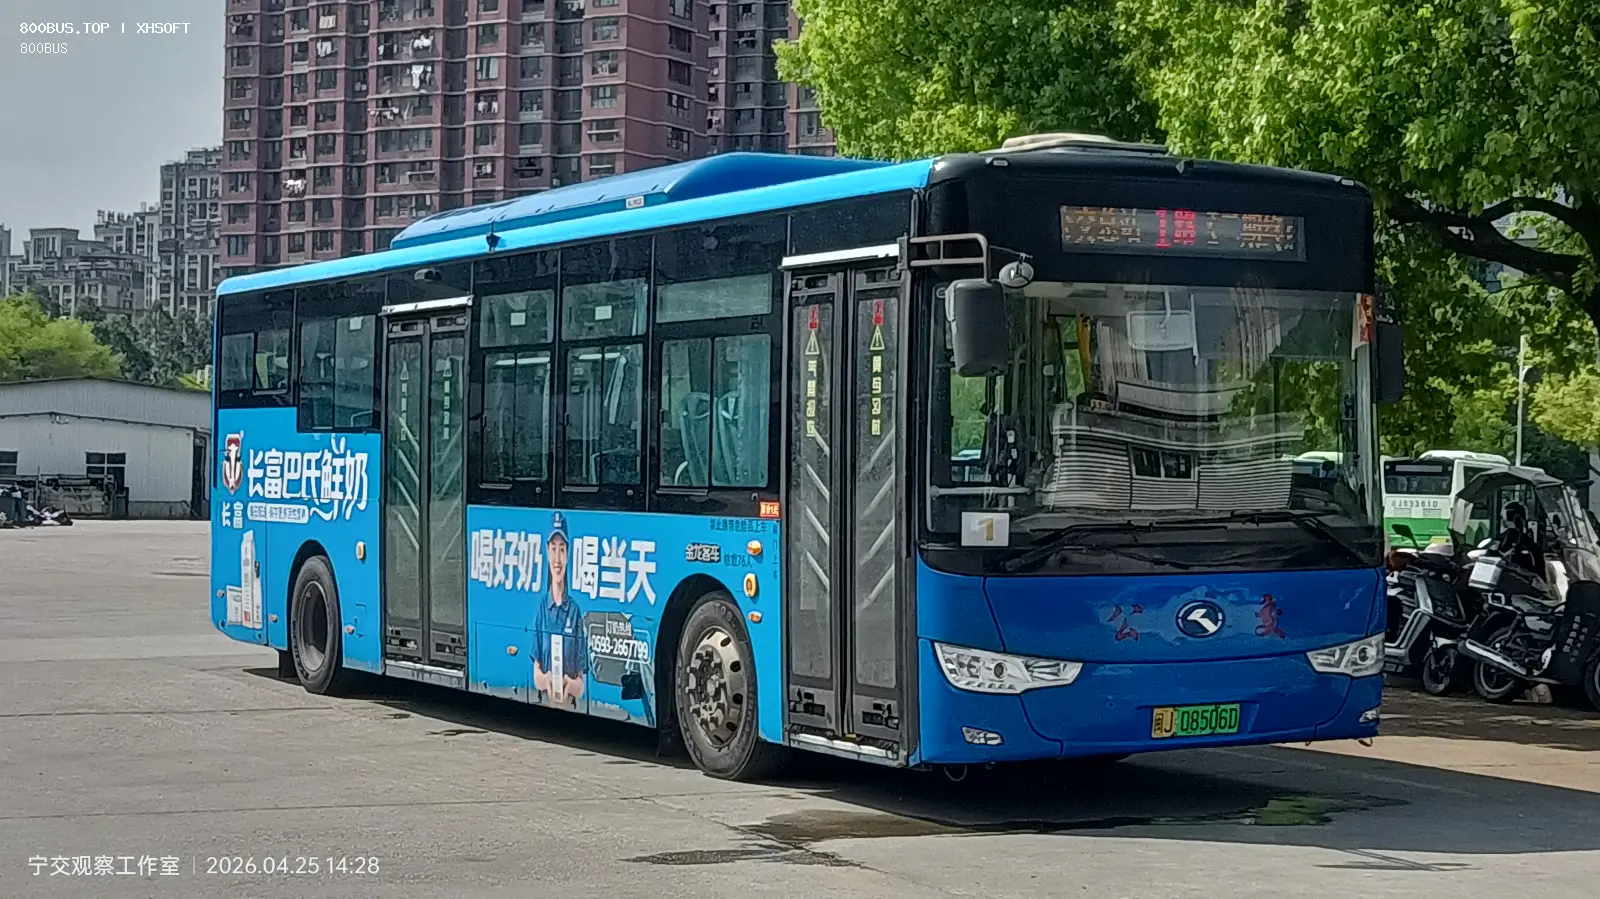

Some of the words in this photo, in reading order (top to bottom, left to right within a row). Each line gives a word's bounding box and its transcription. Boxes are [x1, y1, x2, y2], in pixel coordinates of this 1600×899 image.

[247, 434, 368, 521] 长富巴氏鲜奶
[222, 501, 244, 528] 长富
[470, 529, 542, 593] 喝好奶
[572, 536, 657, 605] 喝当天
[685, 543, 721, 562] 金龙客车
